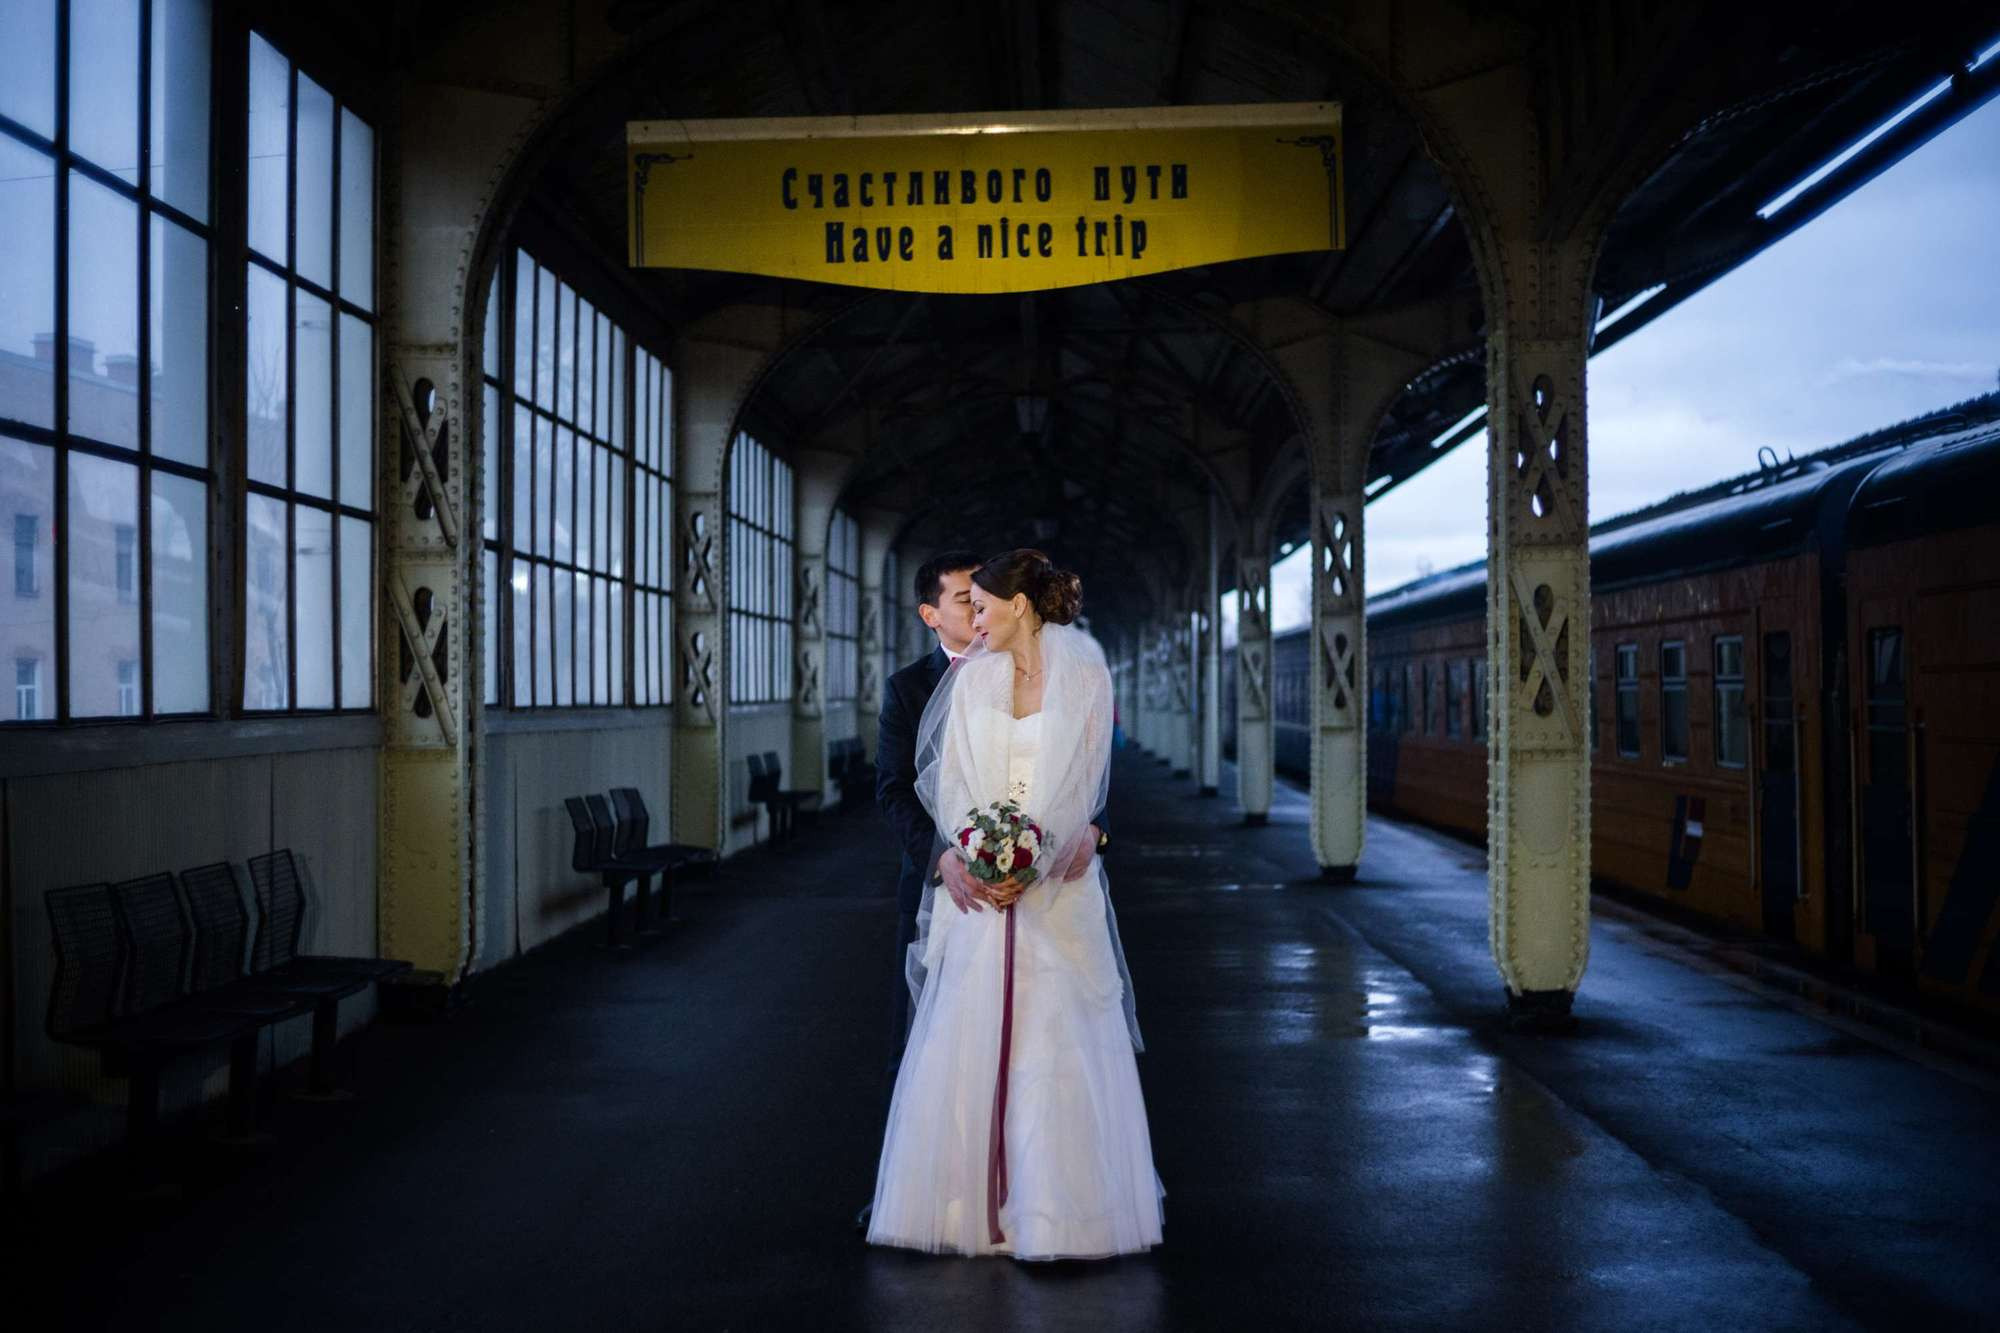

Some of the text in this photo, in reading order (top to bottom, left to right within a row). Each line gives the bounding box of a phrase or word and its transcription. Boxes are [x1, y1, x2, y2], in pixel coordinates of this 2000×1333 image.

[782, 164, 1188, 209] Счастливого пути
[826, 214, 1147, 263] Have a nice trip
